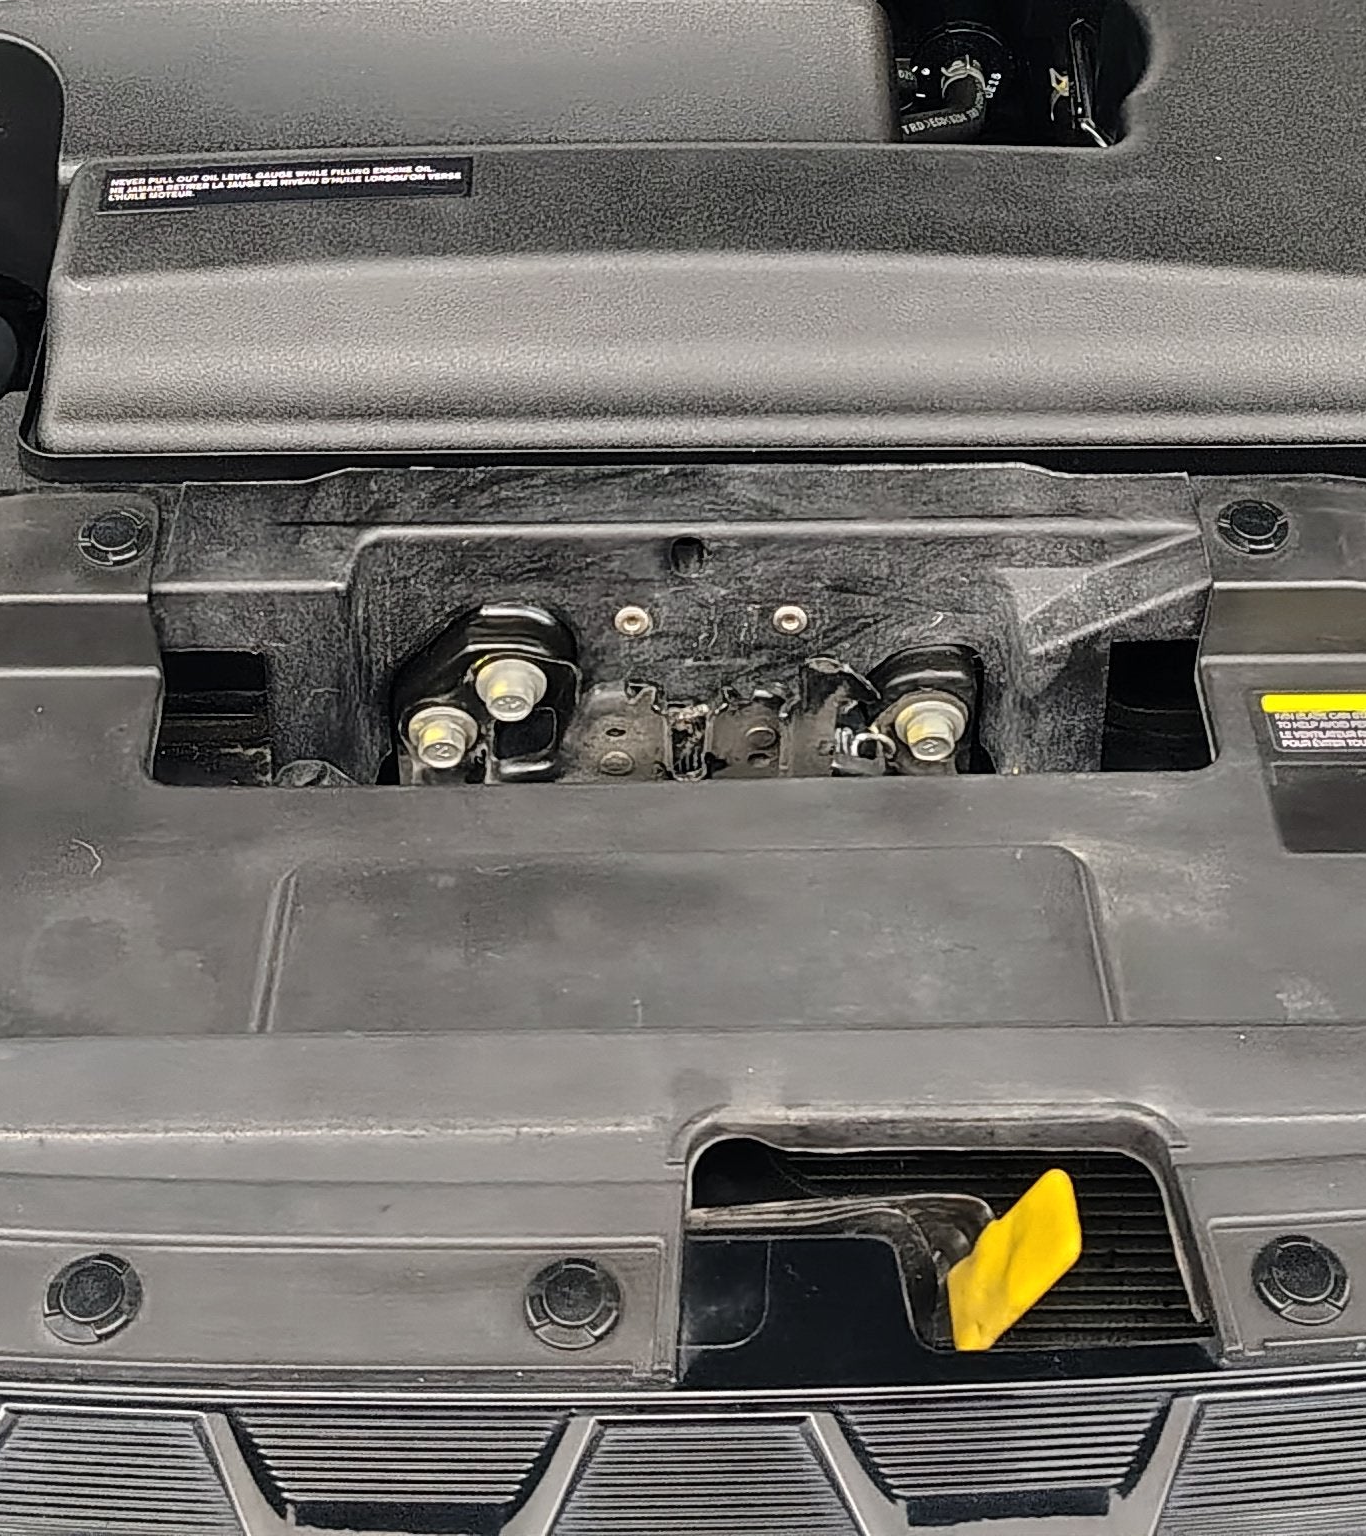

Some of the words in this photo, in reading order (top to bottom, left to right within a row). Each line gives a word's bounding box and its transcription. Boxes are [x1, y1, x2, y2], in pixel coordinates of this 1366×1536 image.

[109, 186, 124, 194] NE
[127, 185, 164, 193] JAMAIS
[212, 181, 225, 189] LA
[227, 180, 261, 188] JAUGE
[263, 179, 278, 187] DE
[280, 177, 319, 186] NIVEAU
[111, 177, 146, 187] NEVER
[148, 176, 174, 185] PULL
[176, 175, 199, 183] OUT
[201, 174, 220, 182] OIL
[221, 172, 253, 181] LEVEL
[255, 171, 293, 179] GAUGE
[295, 169, 328, 177] WHILE
[330, 167, 370, 176] FILLING
